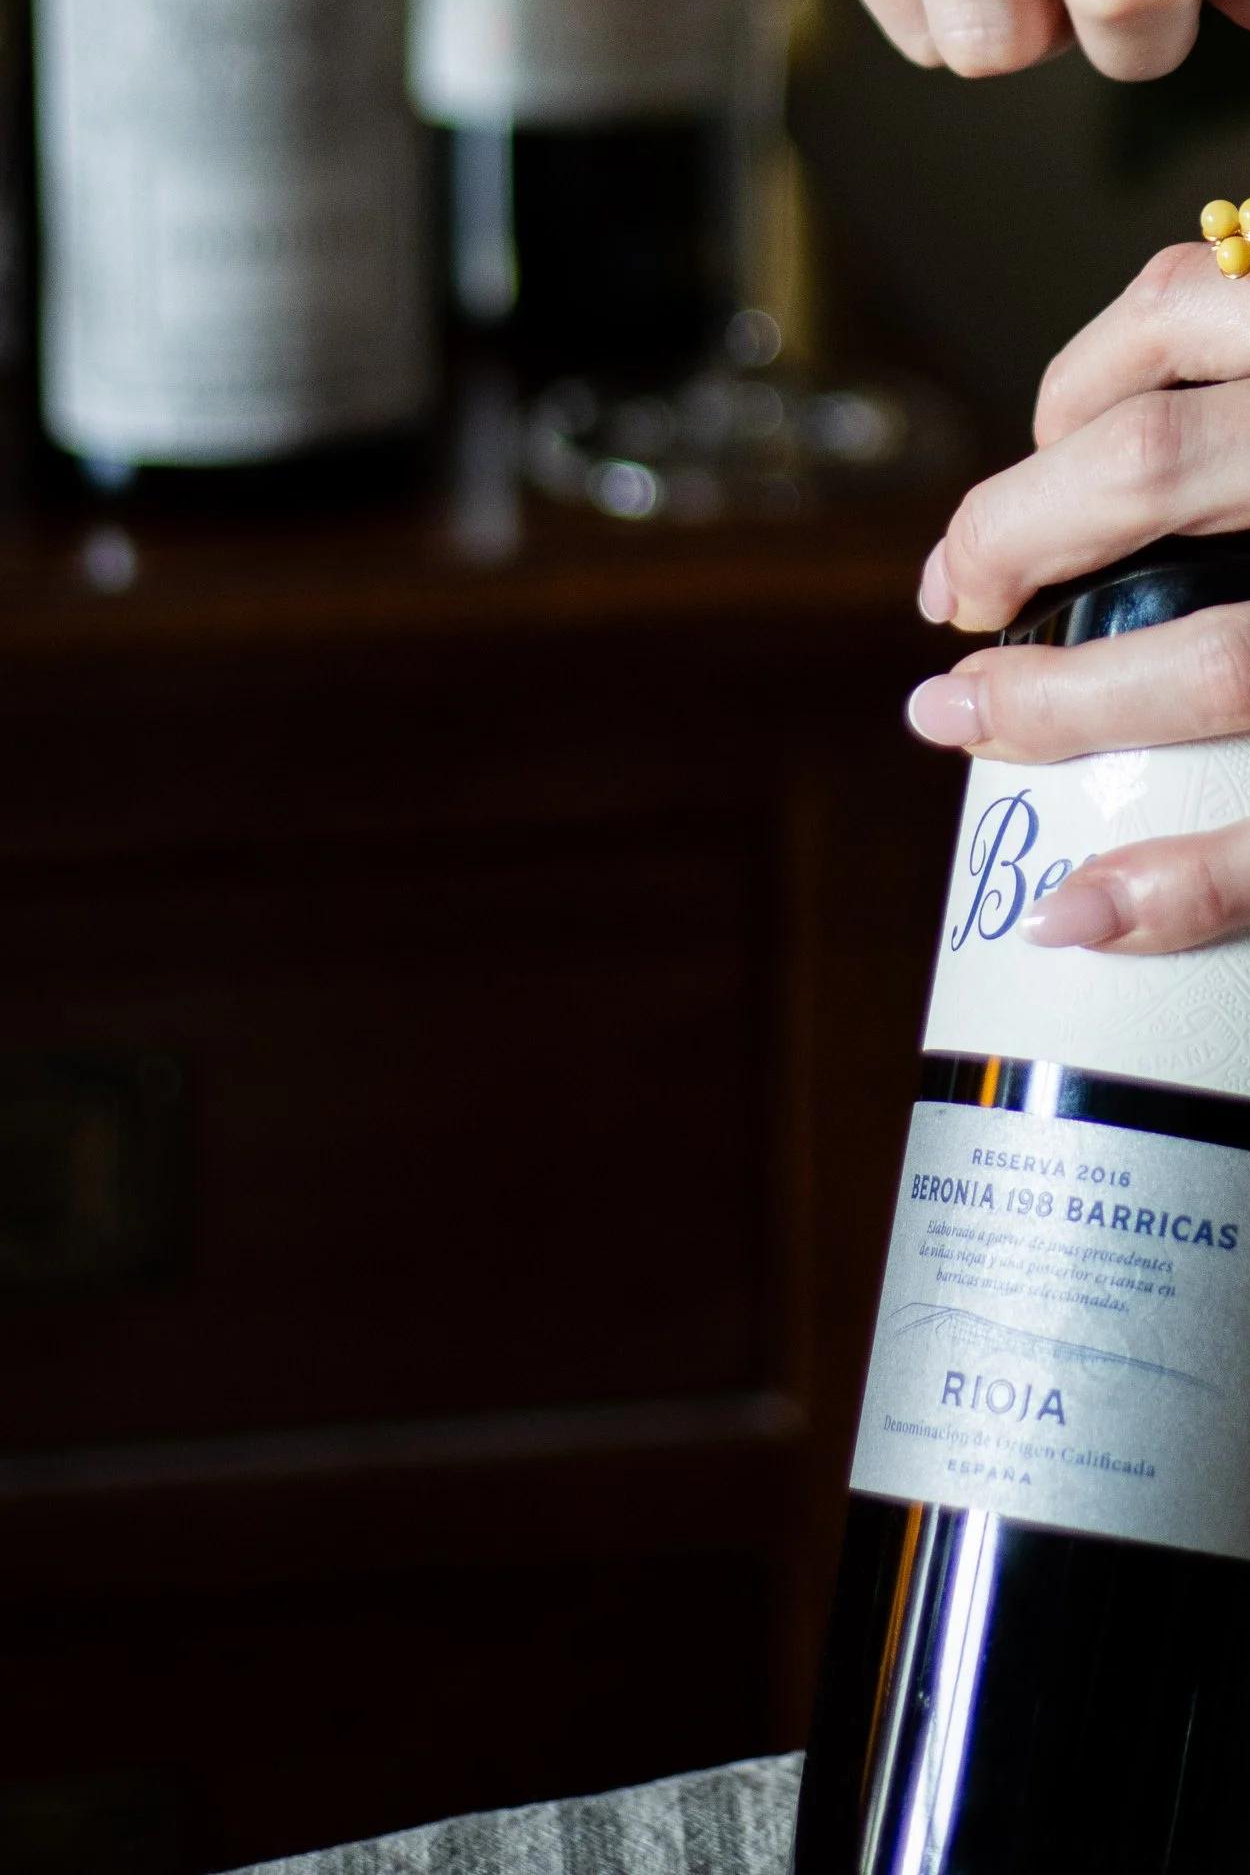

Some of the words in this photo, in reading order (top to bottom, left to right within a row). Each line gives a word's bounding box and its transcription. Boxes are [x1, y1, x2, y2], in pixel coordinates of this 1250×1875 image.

[950, 787, 1097, 952] Be
[971, 1148, 1066, 1178] RESERVA
[1075, 1163, 1132, 1188] 2016
[911, 1173, 995, 1210] BERONIA
[1005, 1186, 1055, 1218] 198
[1066, 1195, 1240, 1251] BARRICAS
[919, 1241, 931, 1257] de
[1094, 1272, 1154, 1294] crianza
[1157, 1285, 1176, 1298] en
[927, 1219, 975, 1240] Elaborado
[1081, 1246, 1173, 1272] procedentes
[936, 1266, 979, 1286] barricas
[941, 1370, 1066, 1426] RIOJA
[883, 1413, 969, 1446] Denominación
[973, 1429, 991, 1446] de
[996, 1436, 1056, 1461] Origen
[1061, 1446, 1157, 1479] Calificada
[946, 1458, 1033, 1485] ESPAÑA
